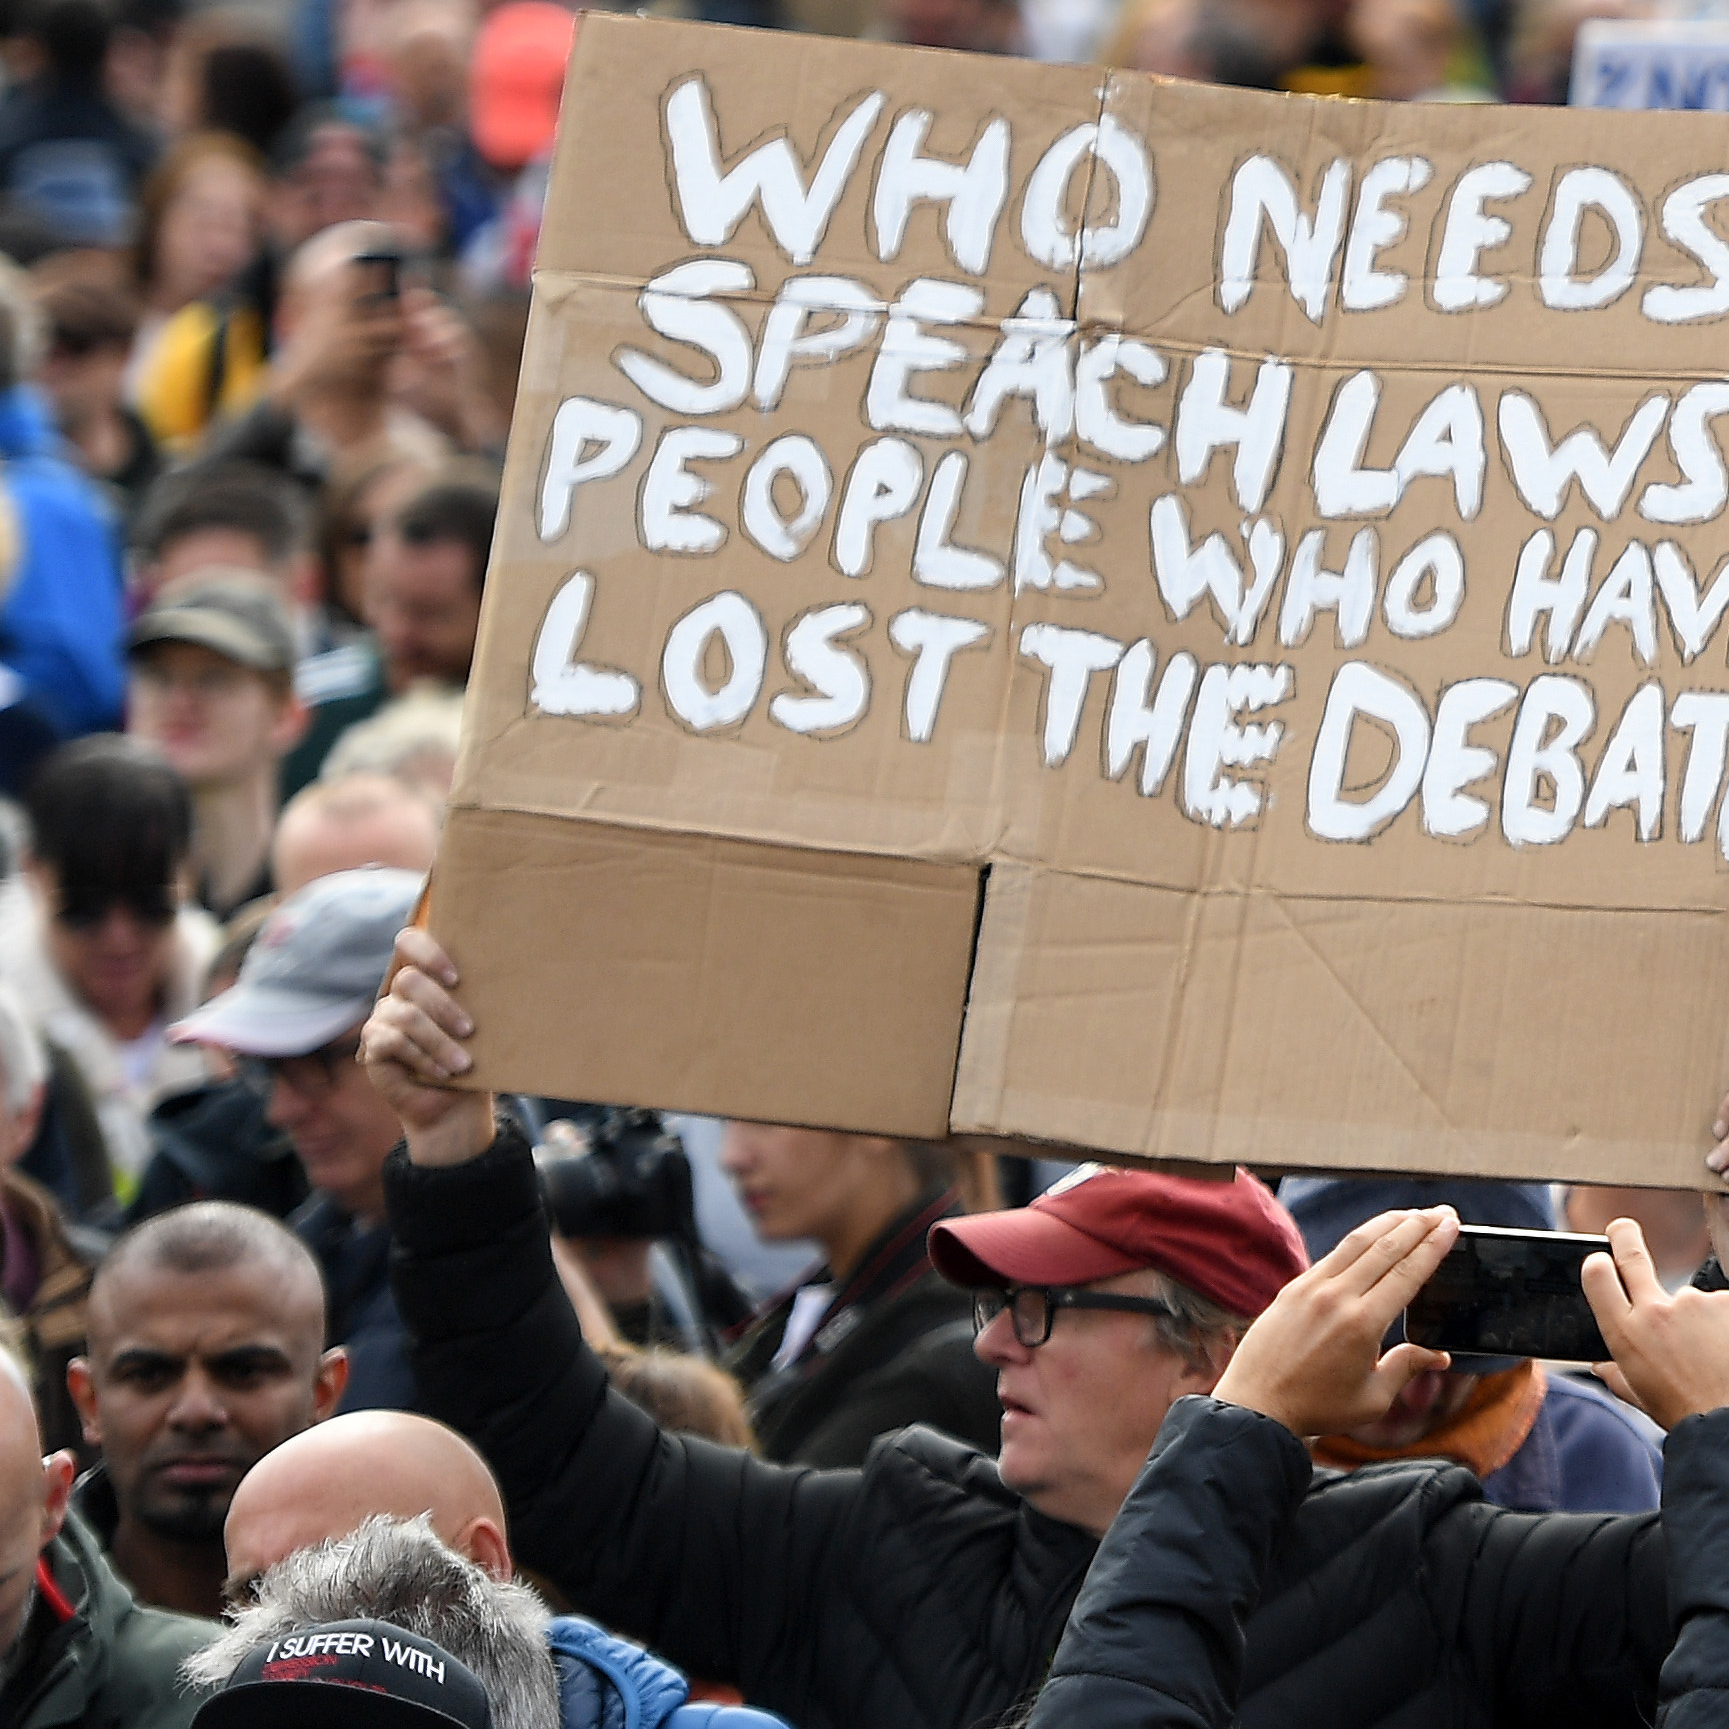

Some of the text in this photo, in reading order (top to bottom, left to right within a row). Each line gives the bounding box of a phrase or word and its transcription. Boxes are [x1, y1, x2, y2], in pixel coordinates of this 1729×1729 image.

[664, 73, 1157, 272] WHO
[615, 258, 1295, 515] SPEACH
[538, 395, 1116, 598] PEOPLE
[1148, 492, 1467, 647] WHO
[530, 570, 990, 741] LOST
[1018, 621, 1295, 829] THE
[266, 1632, 445, 1684] I SUFFER WITH
